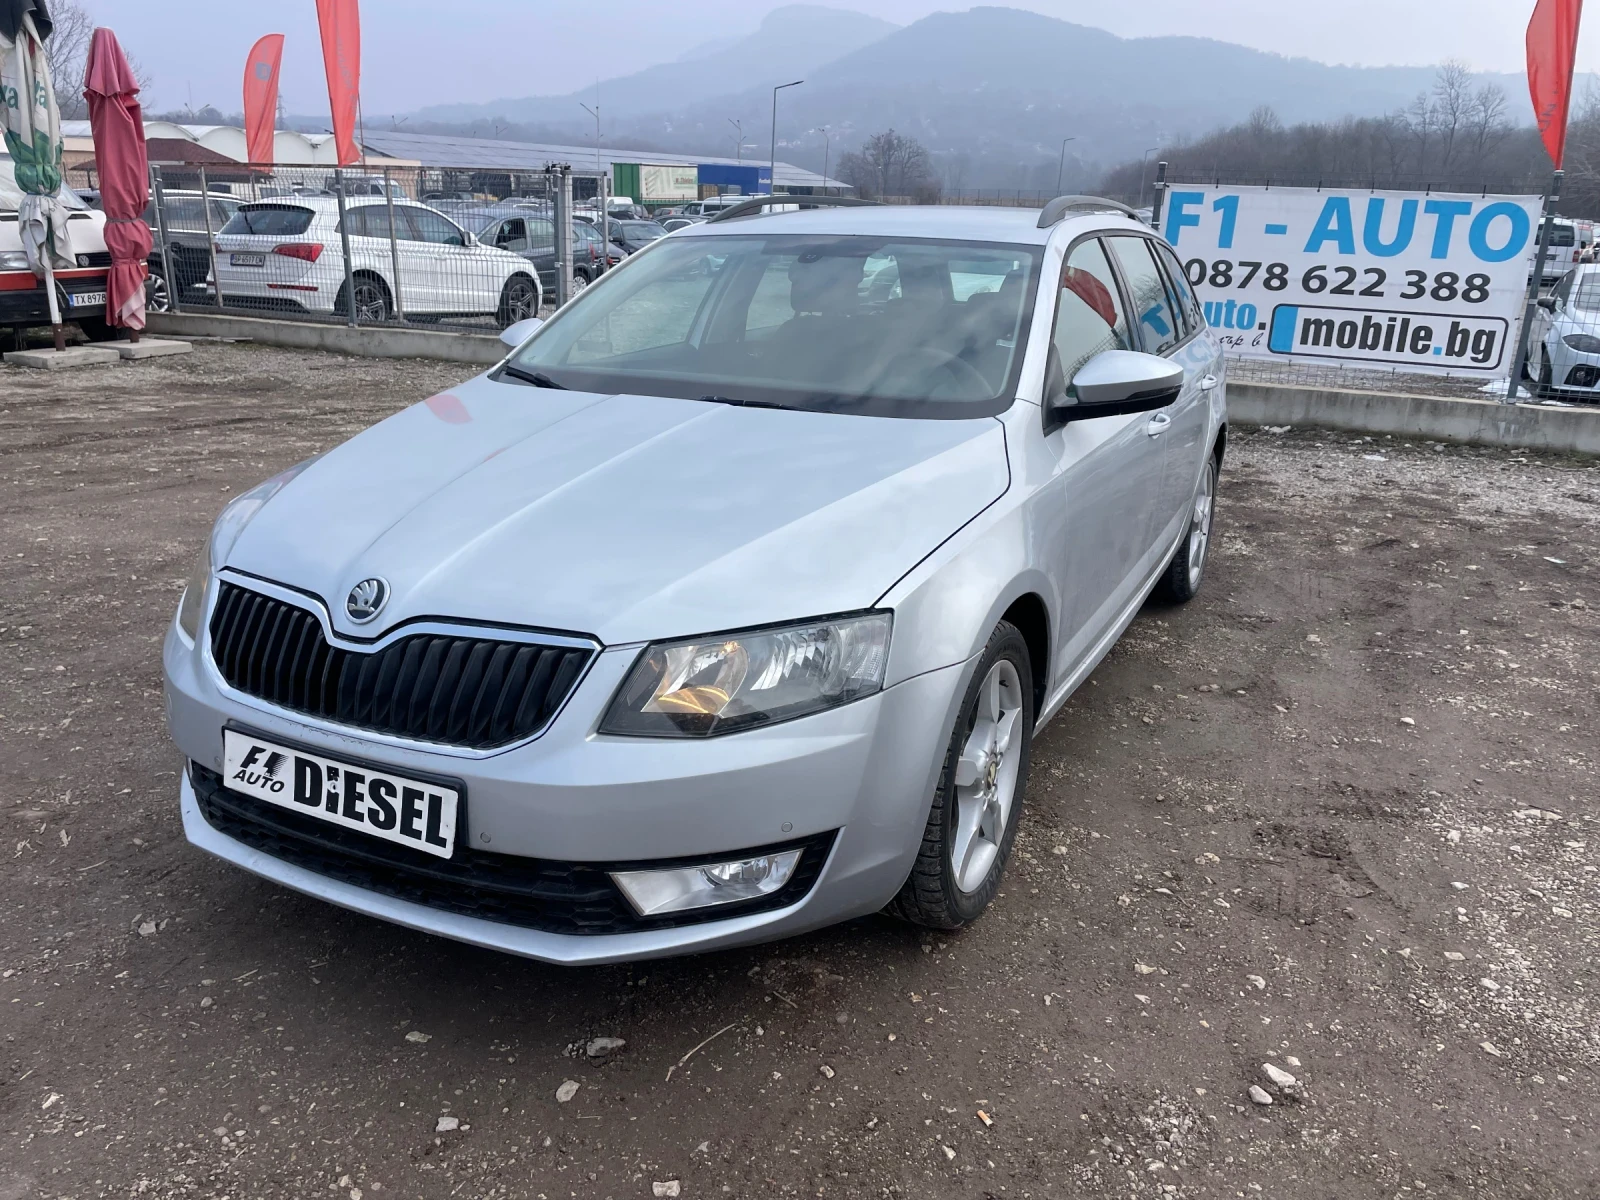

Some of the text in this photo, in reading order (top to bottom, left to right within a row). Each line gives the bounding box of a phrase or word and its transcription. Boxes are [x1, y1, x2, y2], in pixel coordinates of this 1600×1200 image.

[1165, 191, 1240, 249] F1
[1303, 196, 1531, 263] AUTO
[87, 293, 107, 304] 8978
[1184, 258, 1491, 304] 0878 622 388
[1300, 315, 1497, 363] mobile.bg
[232, 769, 285, 793] AUTO
